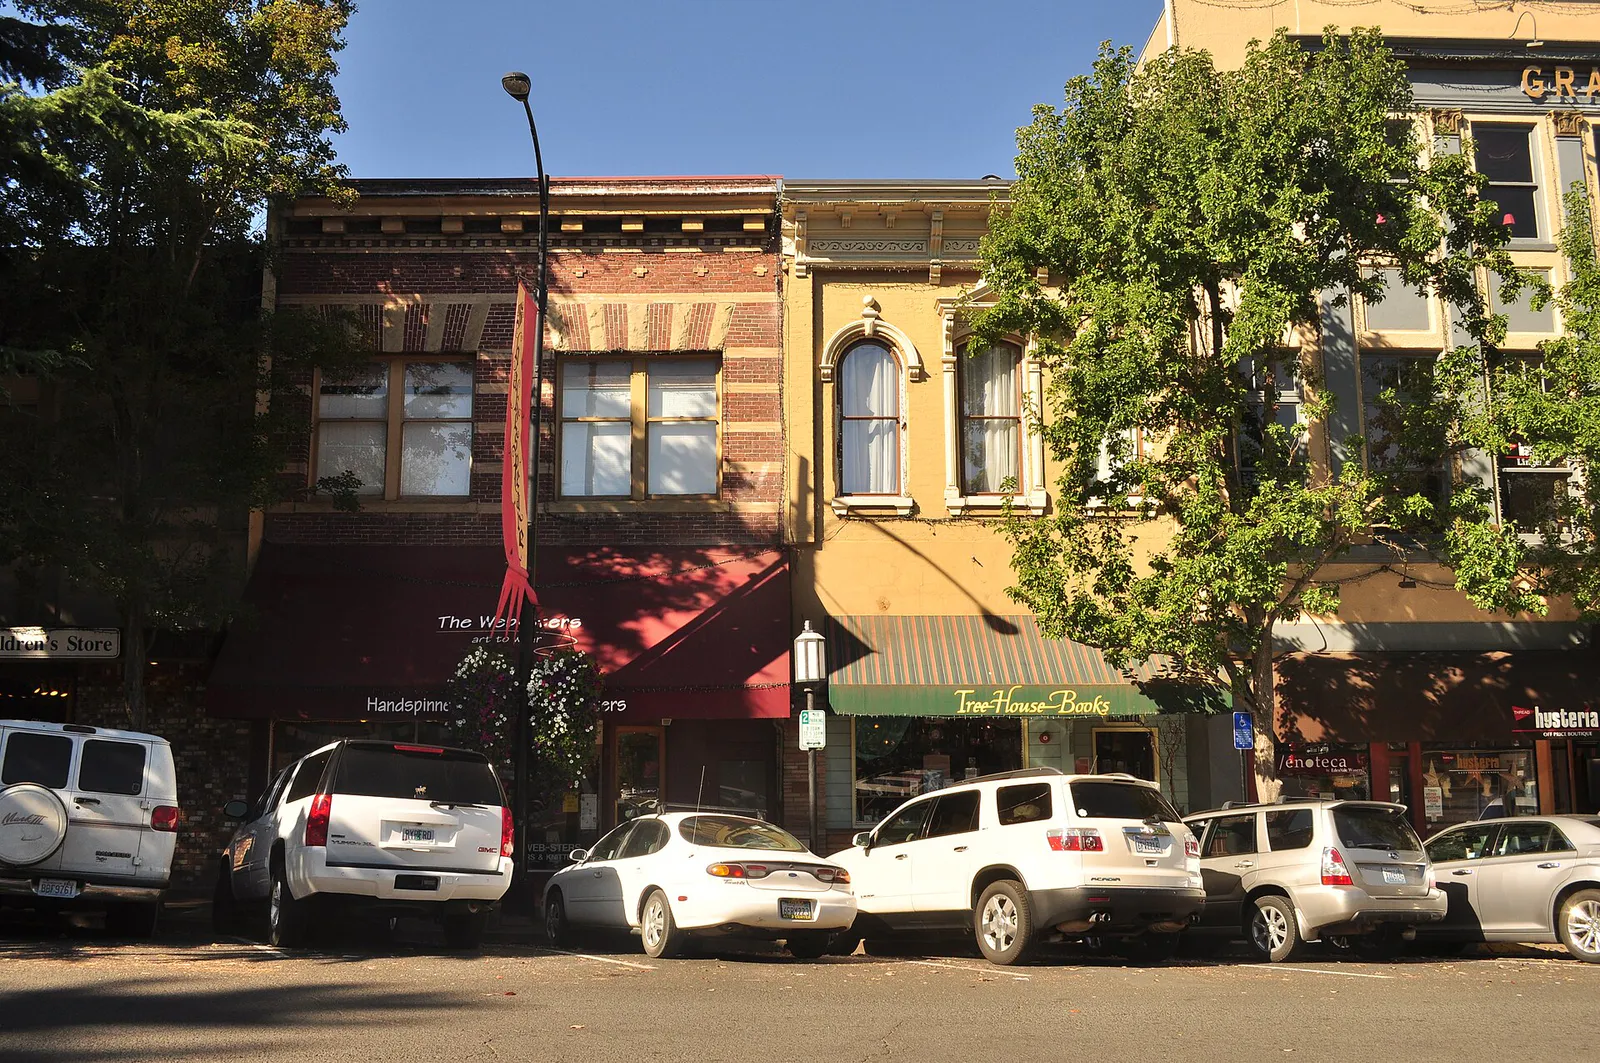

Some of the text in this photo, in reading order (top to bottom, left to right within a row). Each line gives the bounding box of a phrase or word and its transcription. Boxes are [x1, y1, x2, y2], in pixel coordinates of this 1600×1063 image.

[438, 616, 472, 629] The
[67, 636, 113, 652] Store
[1534, 706, 1599, 729] hysteria
